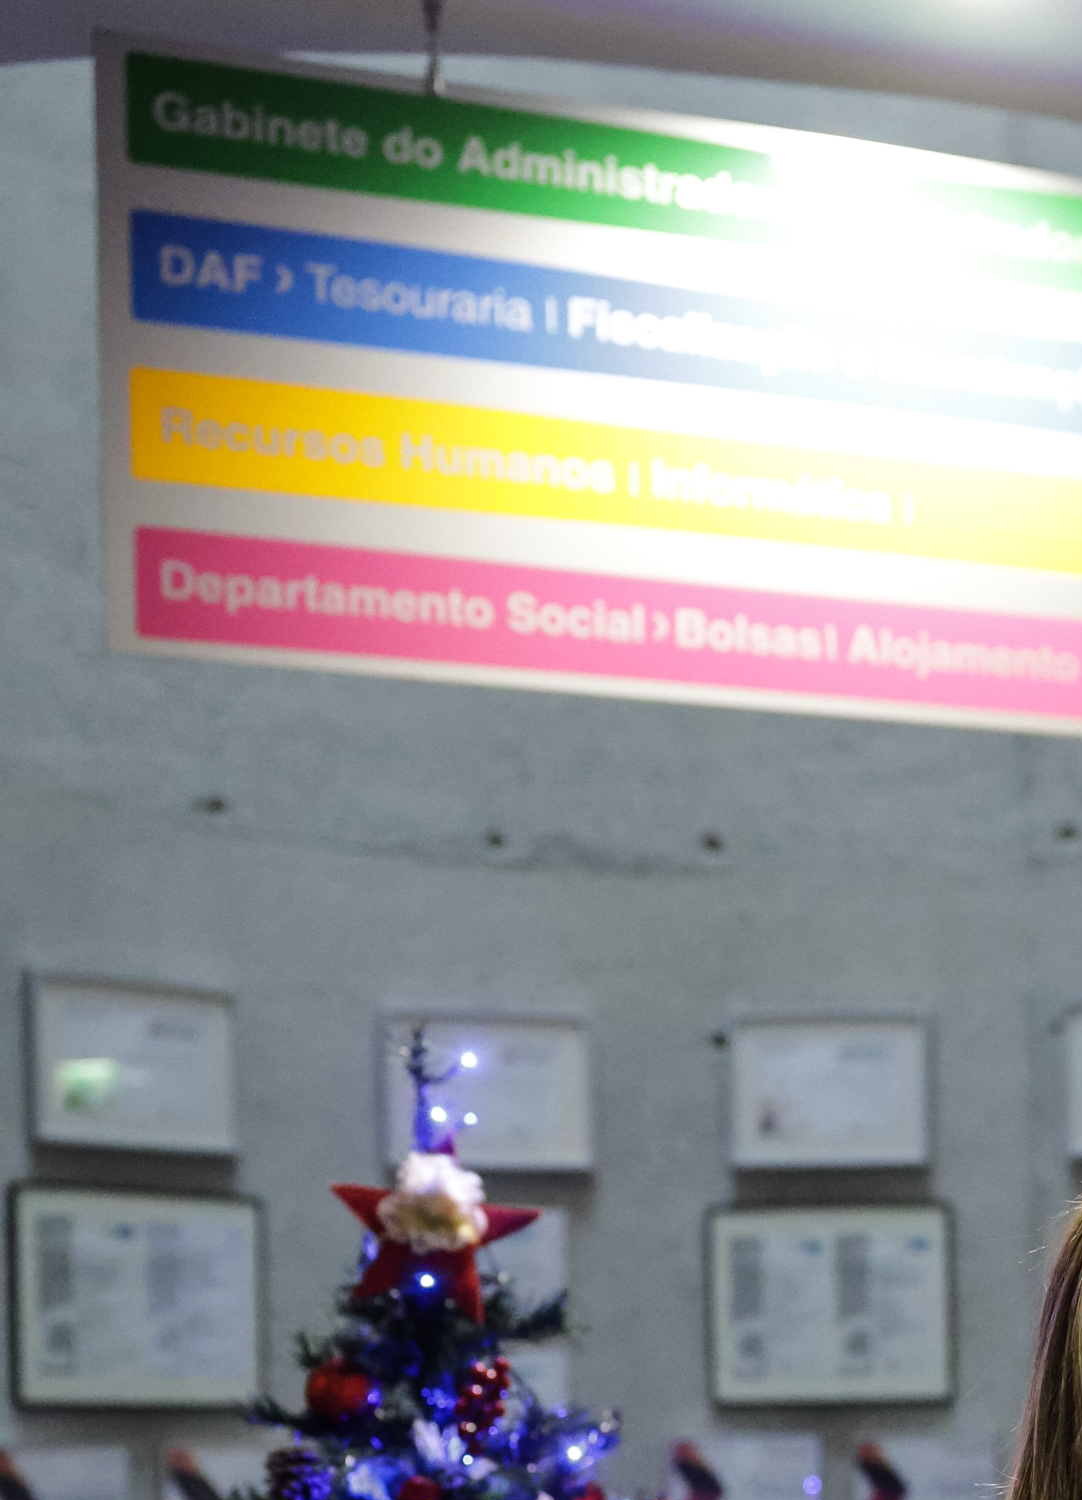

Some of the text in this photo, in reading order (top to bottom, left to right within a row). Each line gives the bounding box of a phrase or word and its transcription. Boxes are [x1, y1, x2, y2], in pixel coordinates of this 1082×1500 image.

[153, 91, 368, 158] Gabinete
[382, 126, 443, 169] do
[159, 244, 262, 293] DAF
[305, 262, 532, 333] Tesouraria
[160, 406, 385, 468] Recursos
[400, 433, 615, 493] Humanos
[159, 560, 494, 629] Departamento
[507, 591, 644, 643] Social
[849, 624, 1080, 684] Alojamento
